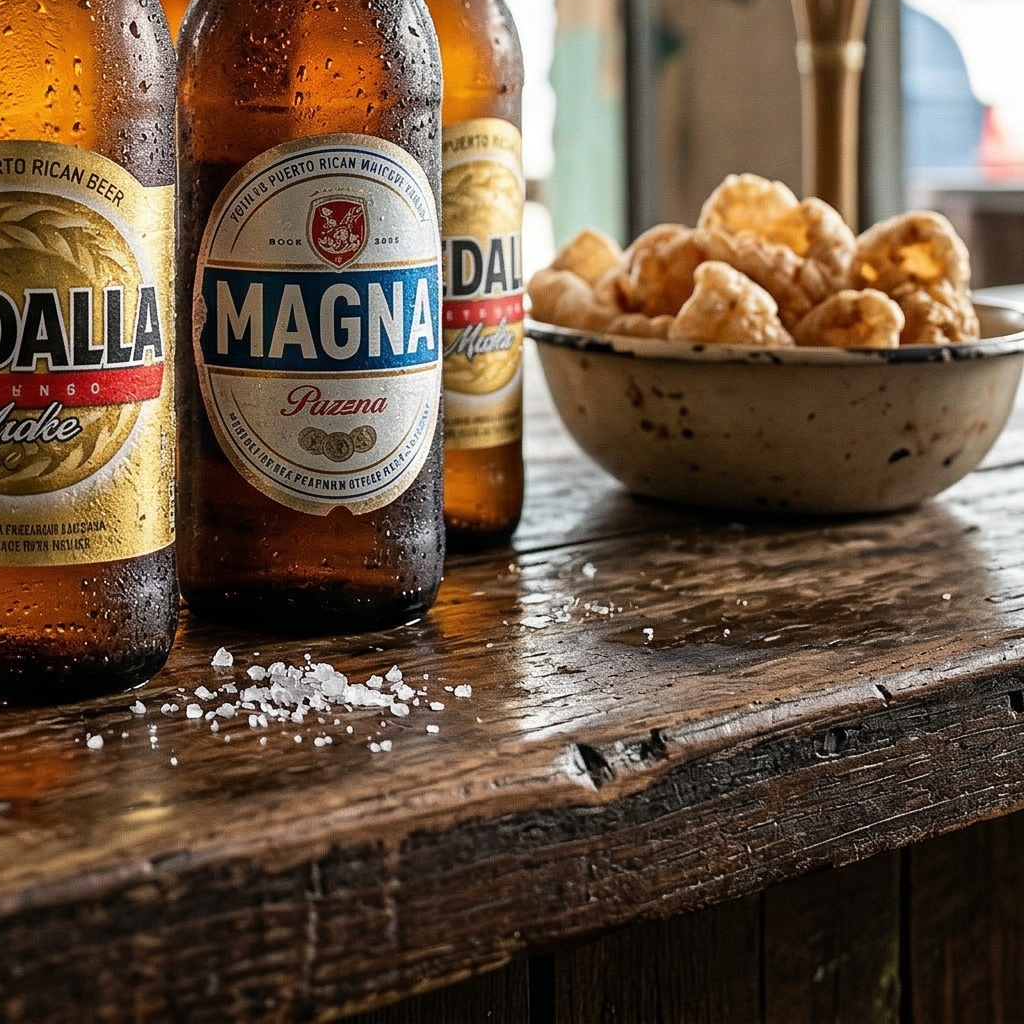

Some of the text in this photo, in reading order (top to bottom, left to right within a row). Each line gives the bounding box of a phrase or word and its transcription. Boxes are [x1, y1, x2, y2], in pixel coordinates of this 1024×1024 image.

[32, 158, 85, 185] RICAN
[86, 173, 125, 207] BEER
[269, 157, 356, 187] PUERTO RICAN
[215, 279, 435, 360] MAGNA
